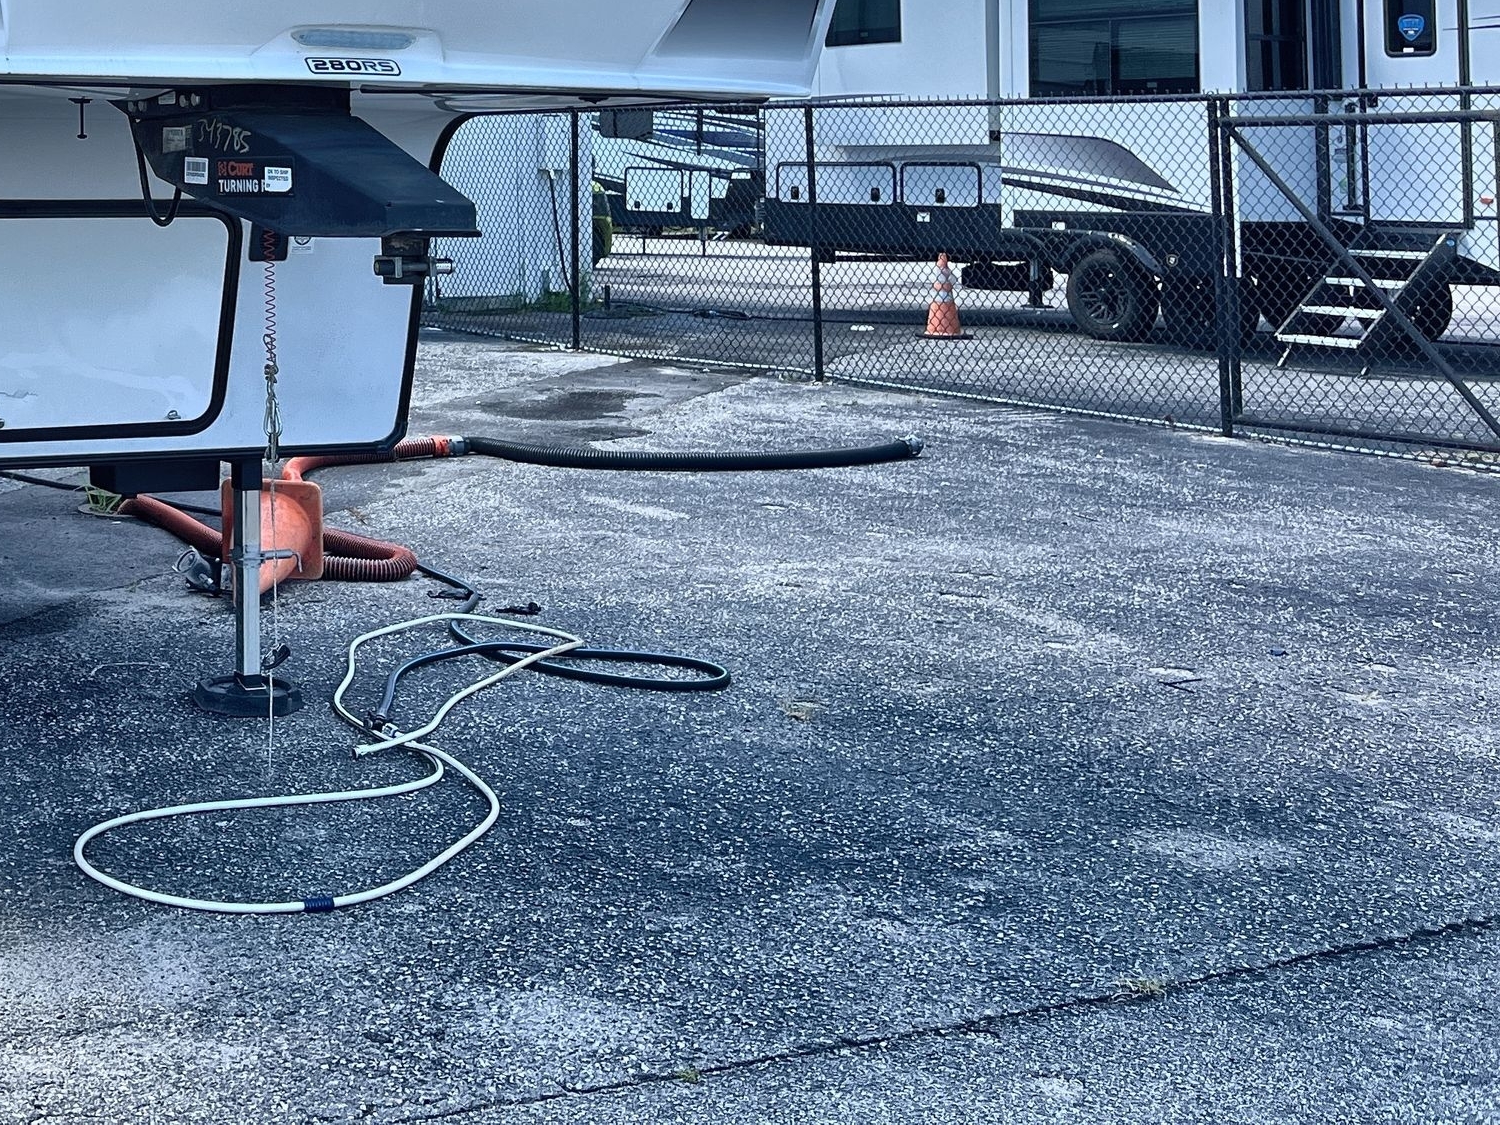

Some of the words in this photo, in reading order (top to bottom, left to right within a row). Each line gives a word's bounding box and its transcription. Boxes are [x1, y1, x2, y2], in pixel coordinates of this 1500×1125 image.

[311, 59, 395, 73] 280RS
[197, 118, 251, 154] 343785
[218, 178, 260, 194] TURNING
